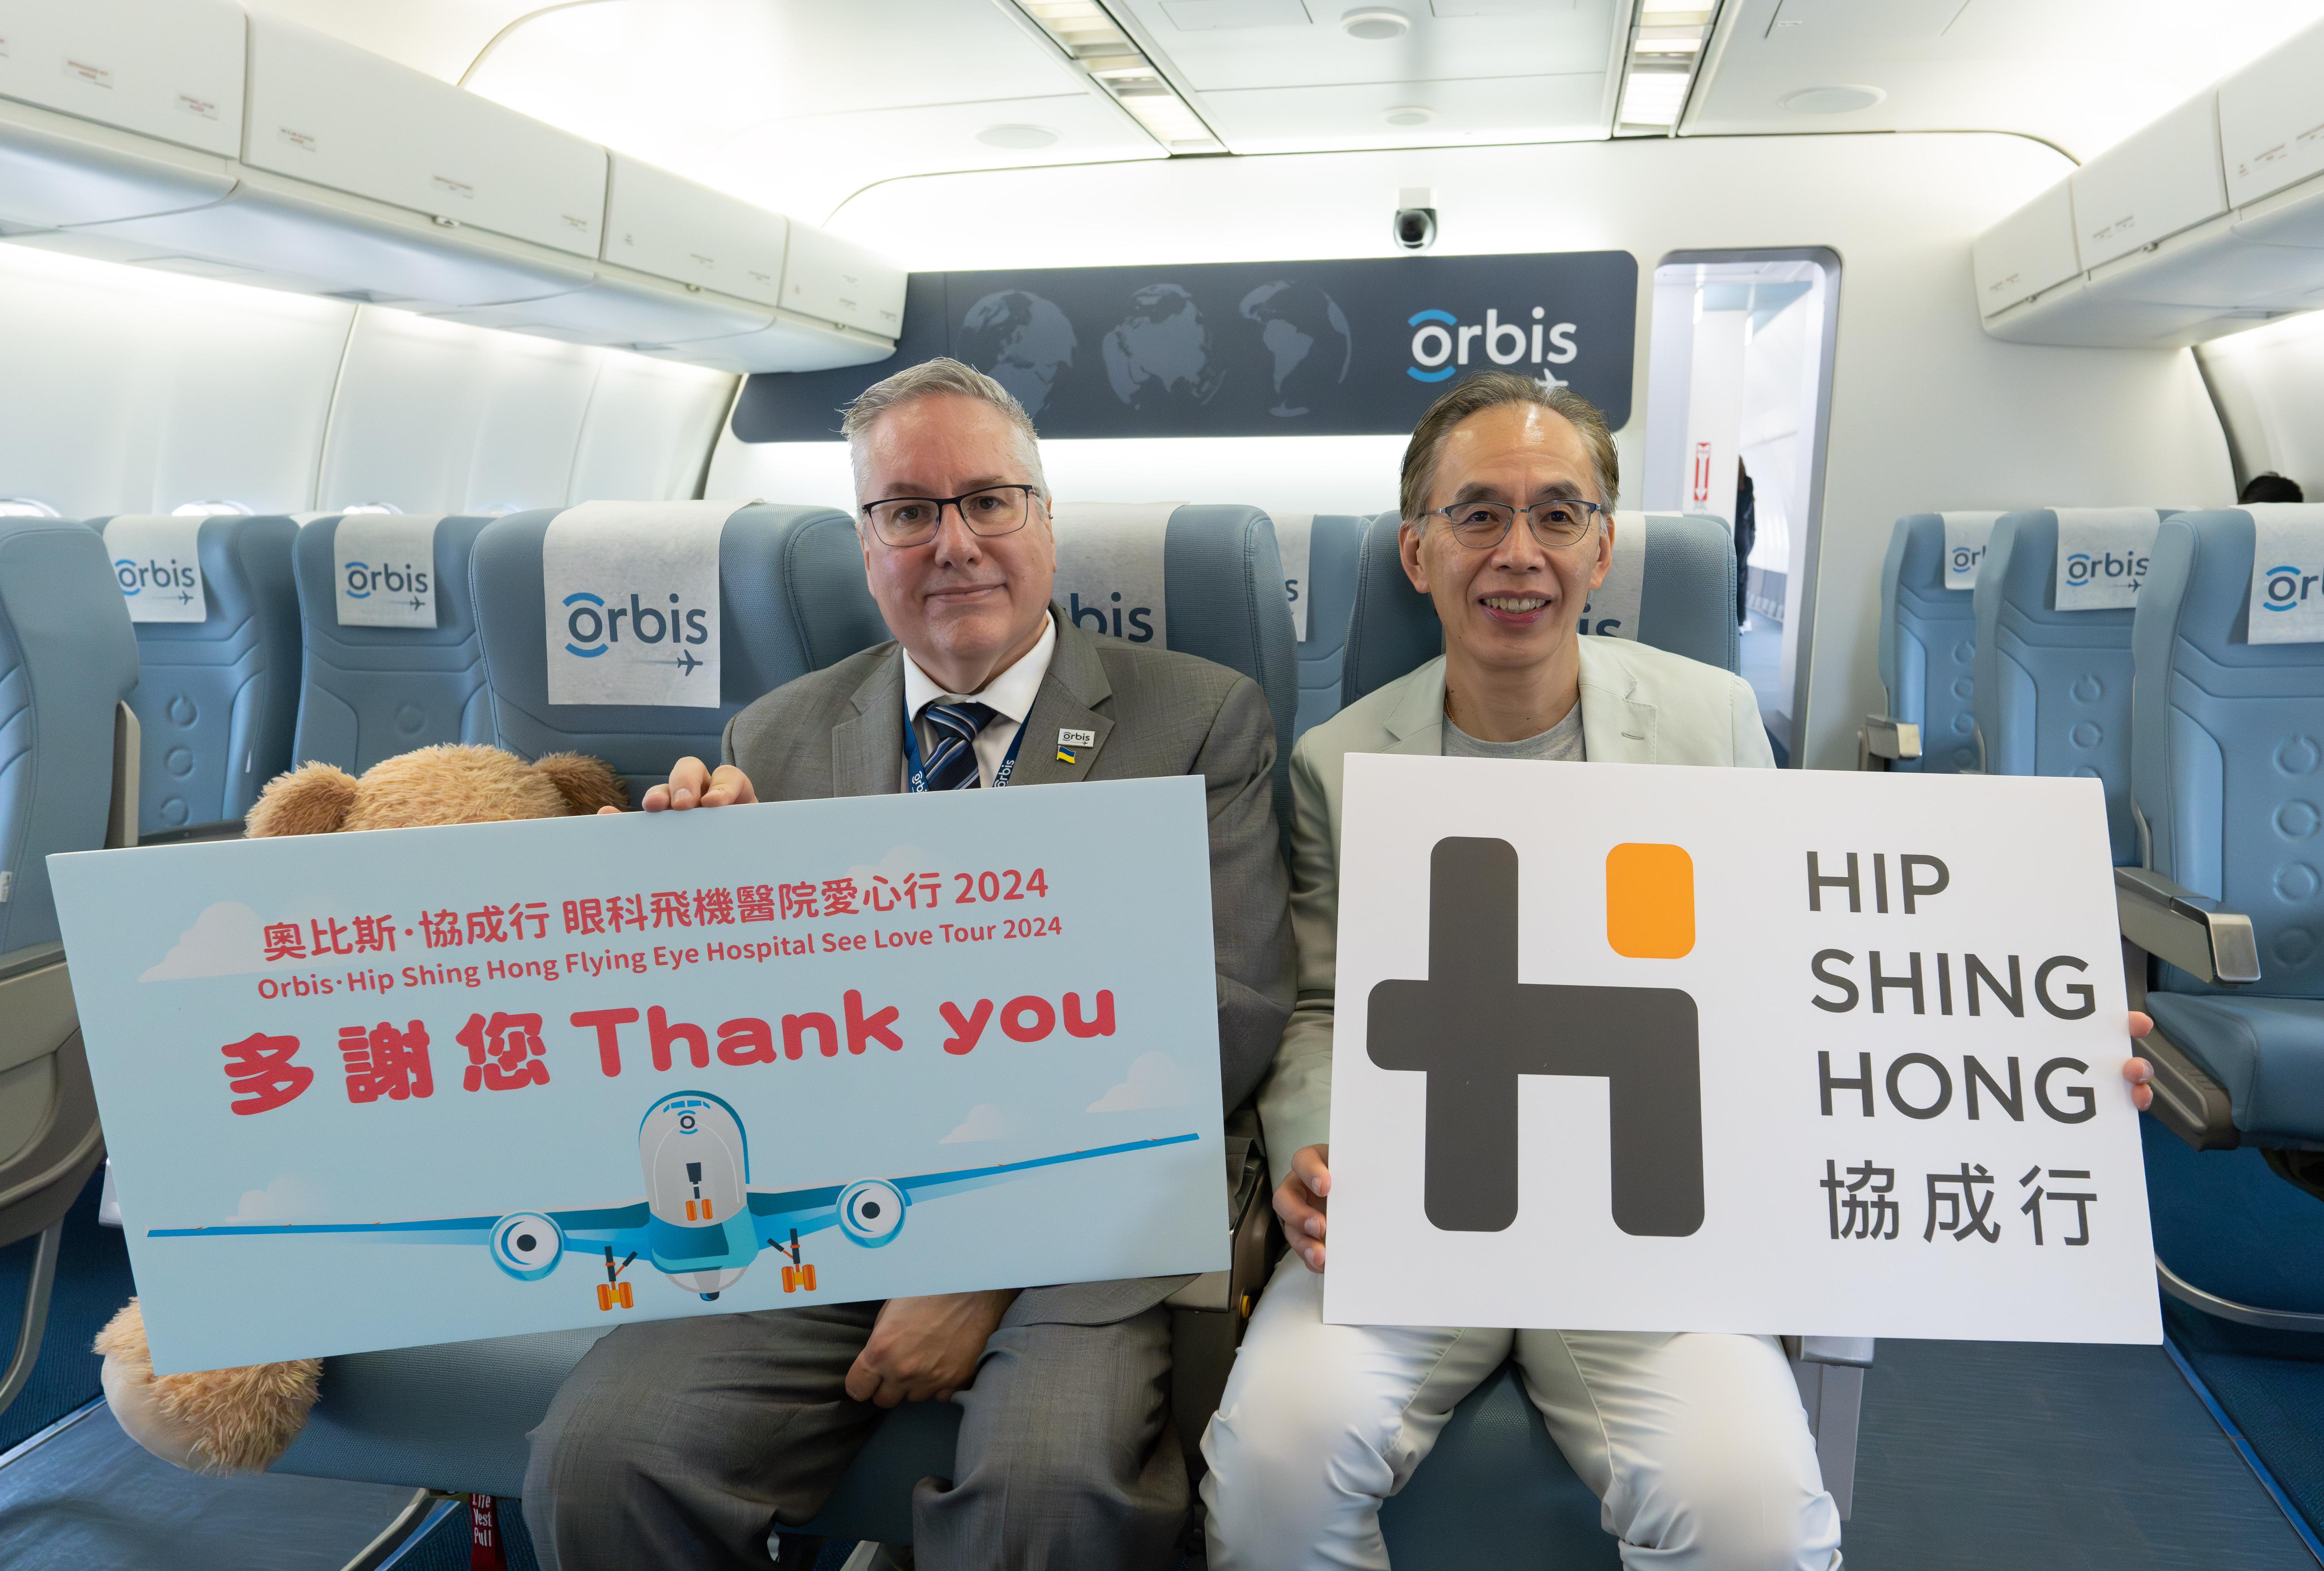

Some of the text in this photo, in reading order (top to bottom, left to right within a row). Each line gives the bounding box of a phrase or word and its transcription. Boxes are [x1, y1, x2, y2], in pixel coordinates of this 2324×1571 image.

[1412, 306, 1578, 367] orbis
[118, 559, 195, 587] orbis
[348, 563, 428, 593] orbis
[568, 594, 708, 644] orbis
[1064, 592, 1154, 643] bis
[1064, 732, 1090, 741] orbis
[562, 873, 941, 935] 眼科飛機醫院愛心行
[955, 868, 1049, 904] 2024
[1807, 851, 1950, 914] HIP
[402, 963, 481, 988] Shing
[487, 960, 559, 981] Hong
[566, 949, 647, 977] Flying
[654, 947, 699, 970] Eye
[707, 934, 815, 962] Hospital
[822, 933, 867, 952] See
[875, 930, 933, 948] Love
[939, 924, 996, 943] Tour
[1003, 916, 1062, 939] 2024
[1811, 948, 2096, 1020] SHING
[570, 990, 903, 1077] Thank
[939, 989, 1116, 1055] you
[1817, 1050, 2097, 1124] HONG
[1820, 1159, 2098, 1246] 協成行
[473, 1508, 492, 1527] Vest
[474, 1527, 492, 1547] Pull
